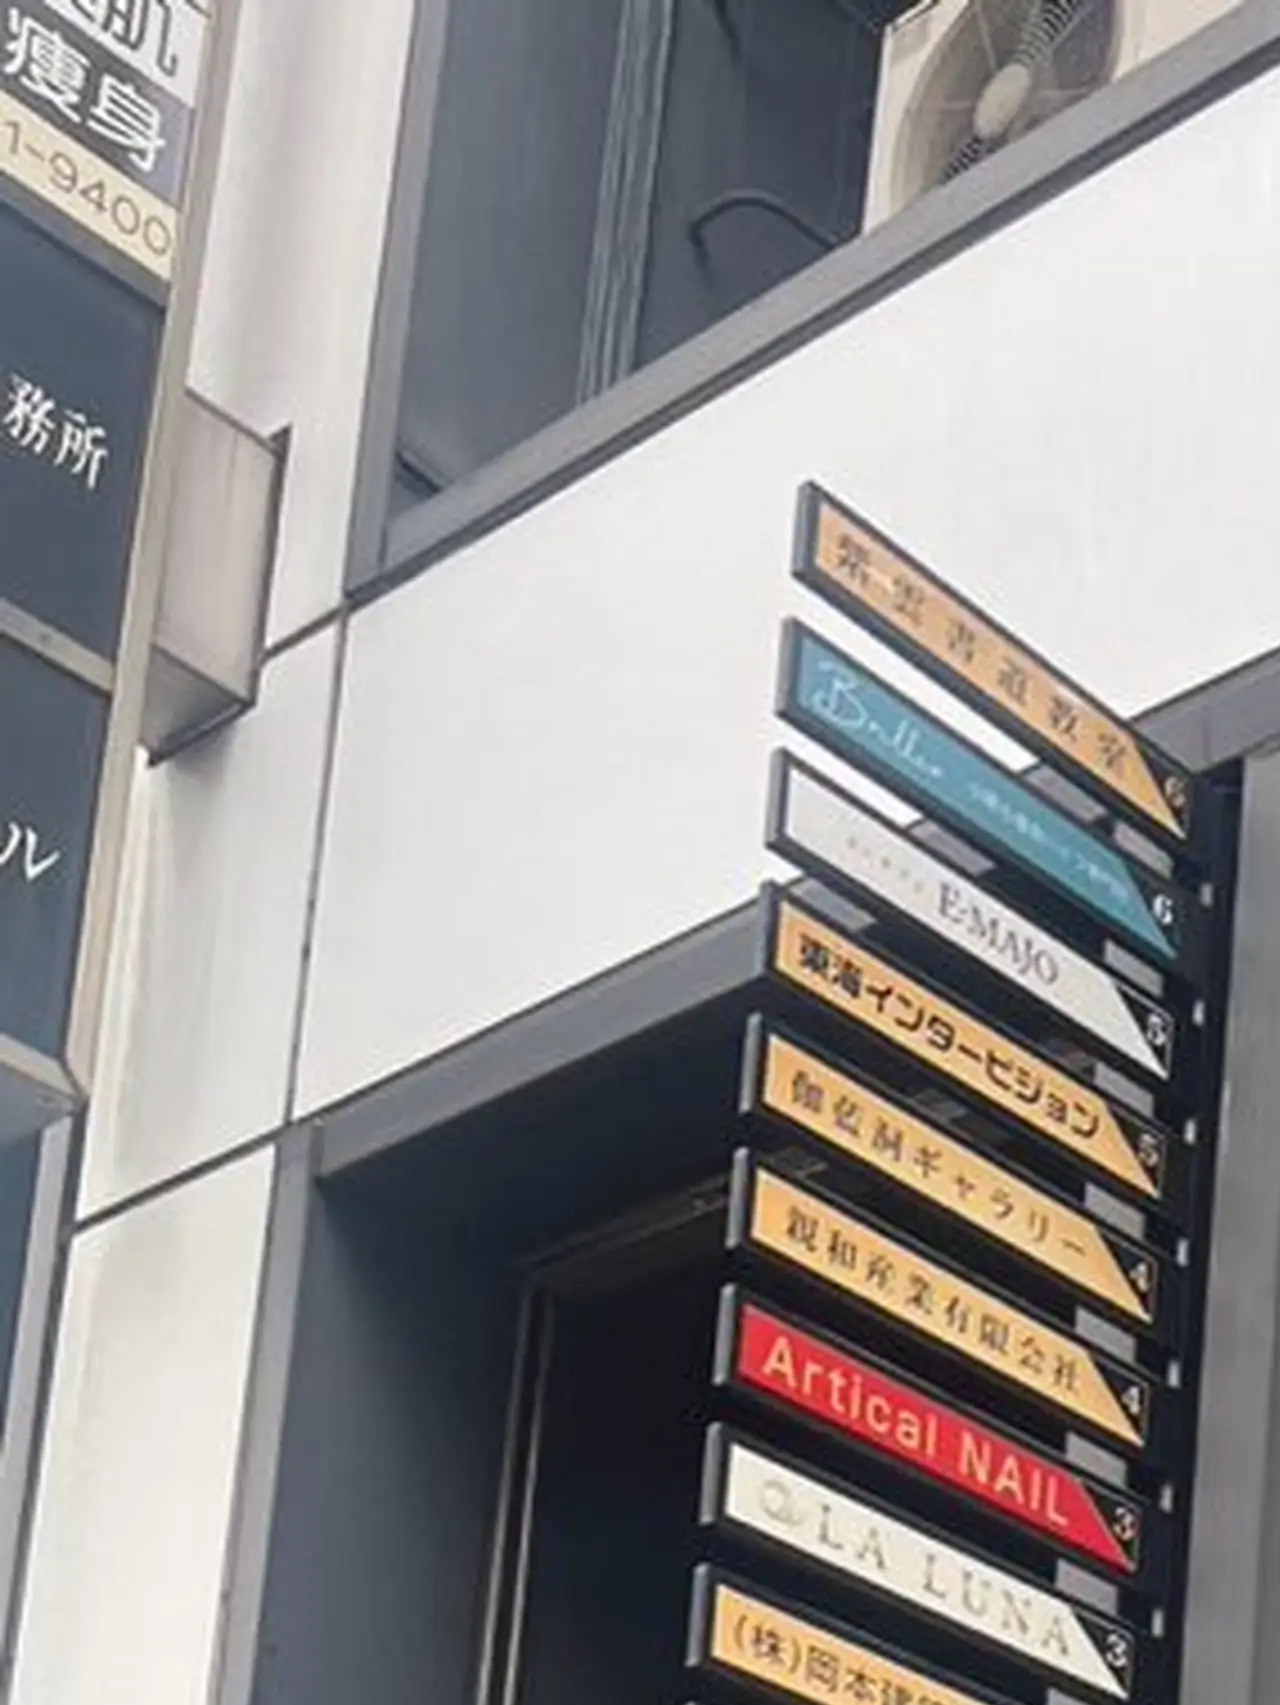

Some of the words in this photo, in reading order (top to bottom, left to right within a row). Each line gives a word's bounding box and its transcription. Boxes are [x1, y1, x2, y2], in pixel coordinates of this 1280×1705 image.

[4, 8, 166, 171] 痩身
[1152, 894, 1173, 923] 6
[797, 934, 1101, 1139] 東海インタービジョン
[1146, 1013, 1167, 1048] 5
[1137, 1133, 1160, 1167] 5
[1129, 1262, 1151, 1293] 4
[1122, 1386, 1142, 1414] 4
[762, 1336, 936, 1457] Artical
[959, 1428, 1069, 1527] NAIL
[1114, 1507, 1138, 1540] 3
[819, 1504, 888, 1573] LA
[925, 1551, 1073, 1658] LUNA
[1106, 1634, 1129, 1667] 3
